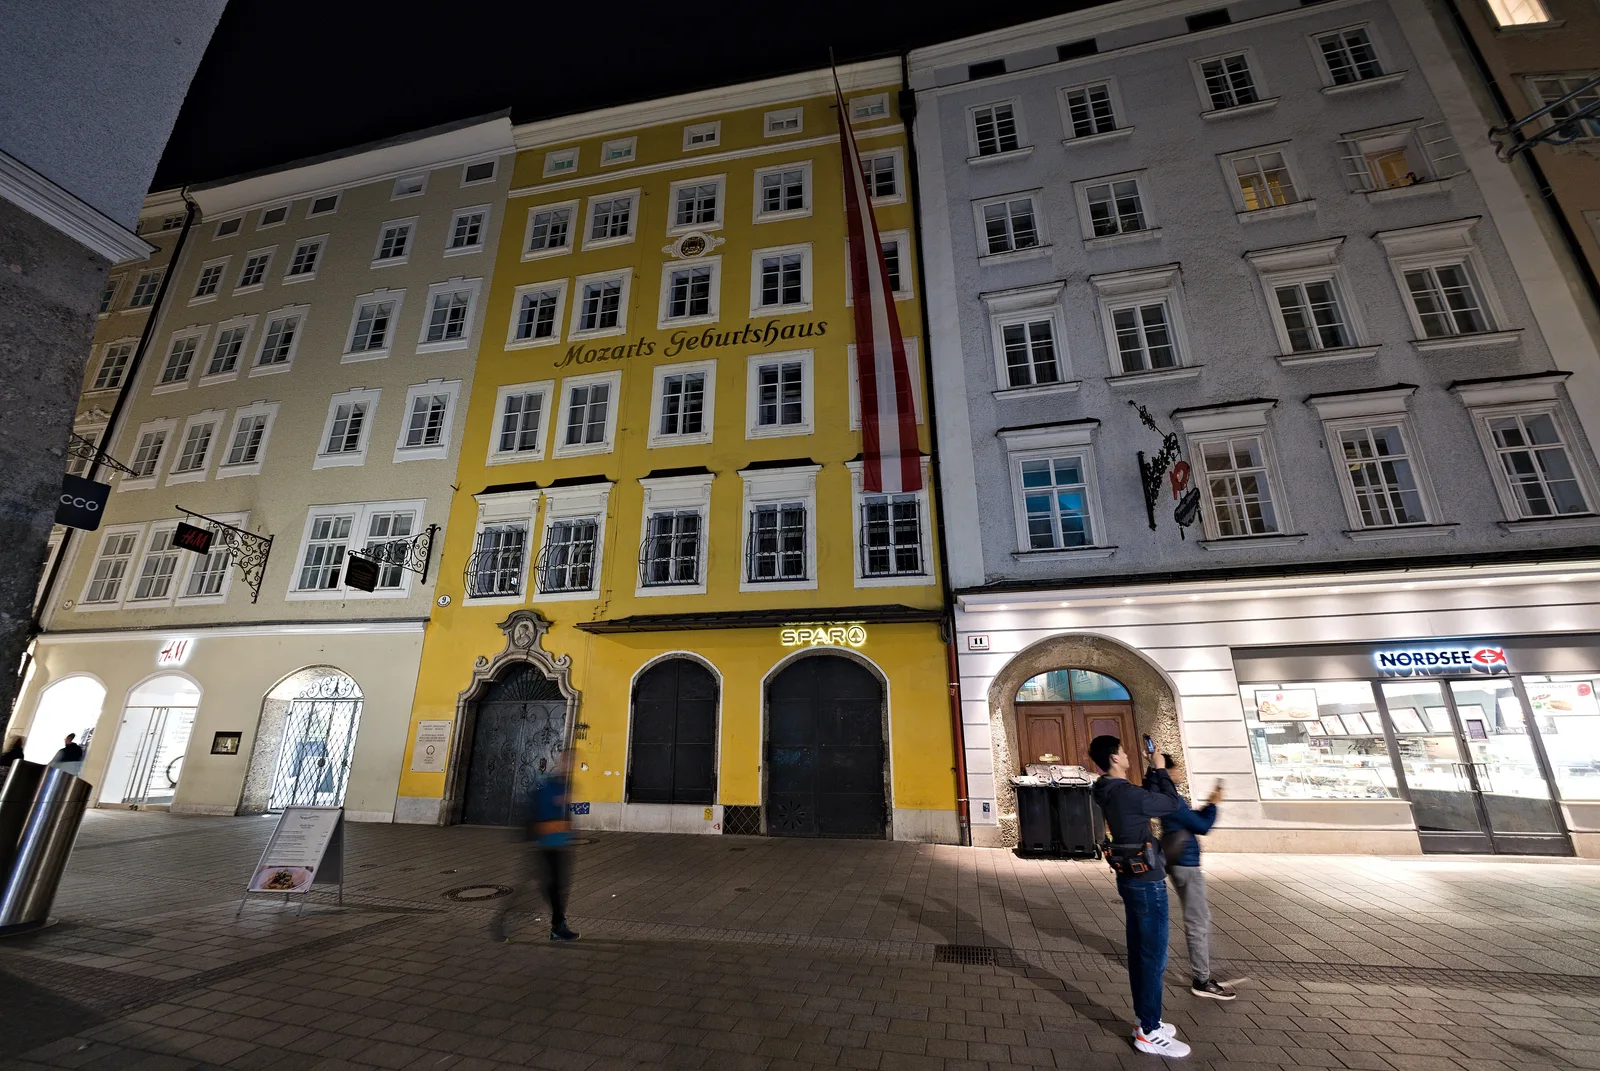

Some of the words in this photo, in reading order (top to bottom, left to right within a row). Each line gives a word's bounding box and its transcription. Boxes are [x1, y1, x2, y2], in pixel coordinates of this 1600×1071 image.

[553, 336, 656, 369] Mozarts
[664, 319, 828, 358] Geburtshaus
[60, 494, 99, 511] CCO
[782, 629, 845, 643] SPAR
[974, 637, 983, 645] 11
[1379, 650, 1472, 666] NORDSEE
